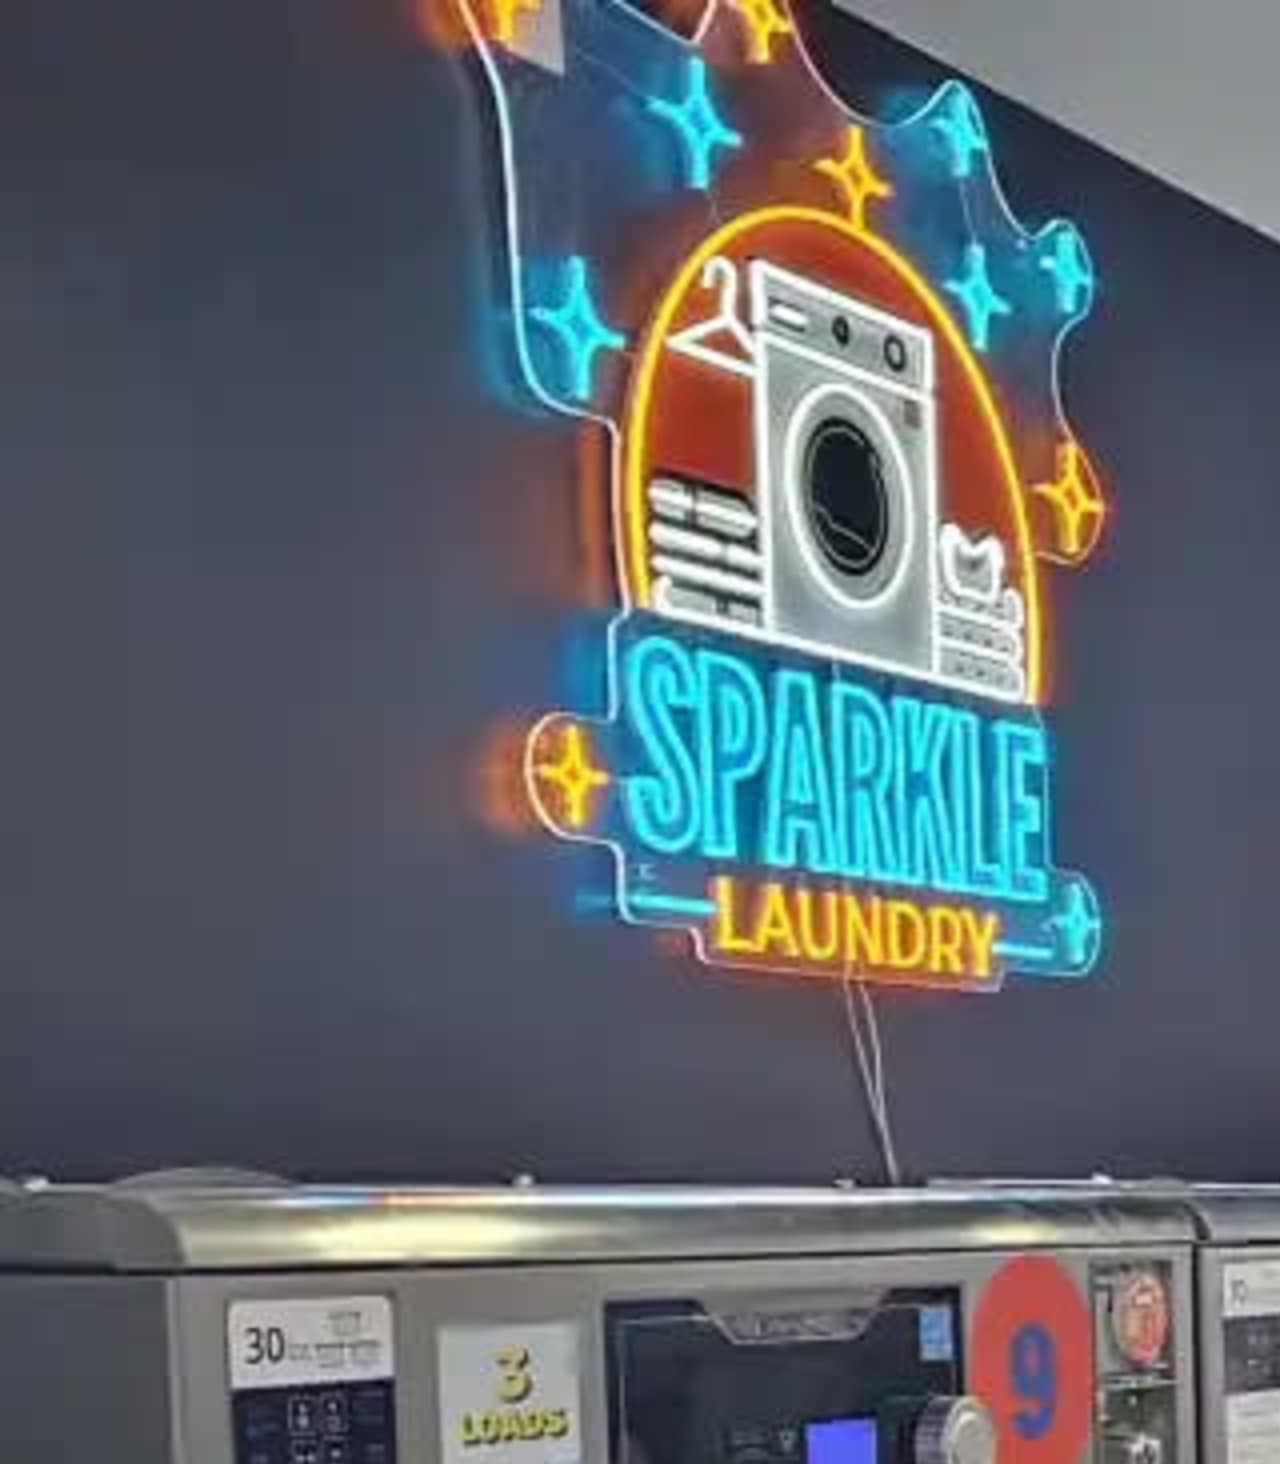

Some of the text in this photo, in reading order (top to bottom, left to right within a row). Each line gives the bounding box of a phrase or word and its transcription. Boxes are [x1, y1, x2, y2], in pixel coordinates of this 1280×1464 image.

[624, 635, 1050, 902] SPARKLE
[713, 874, 999, 978] LAUNDRY
[244, 1326, 285, 1365] 30
[493, 1344, 534, 1403] 3
[1009, 1323, 1057, 1440] 9
[458, 1407, 570, 1446] LOADS
